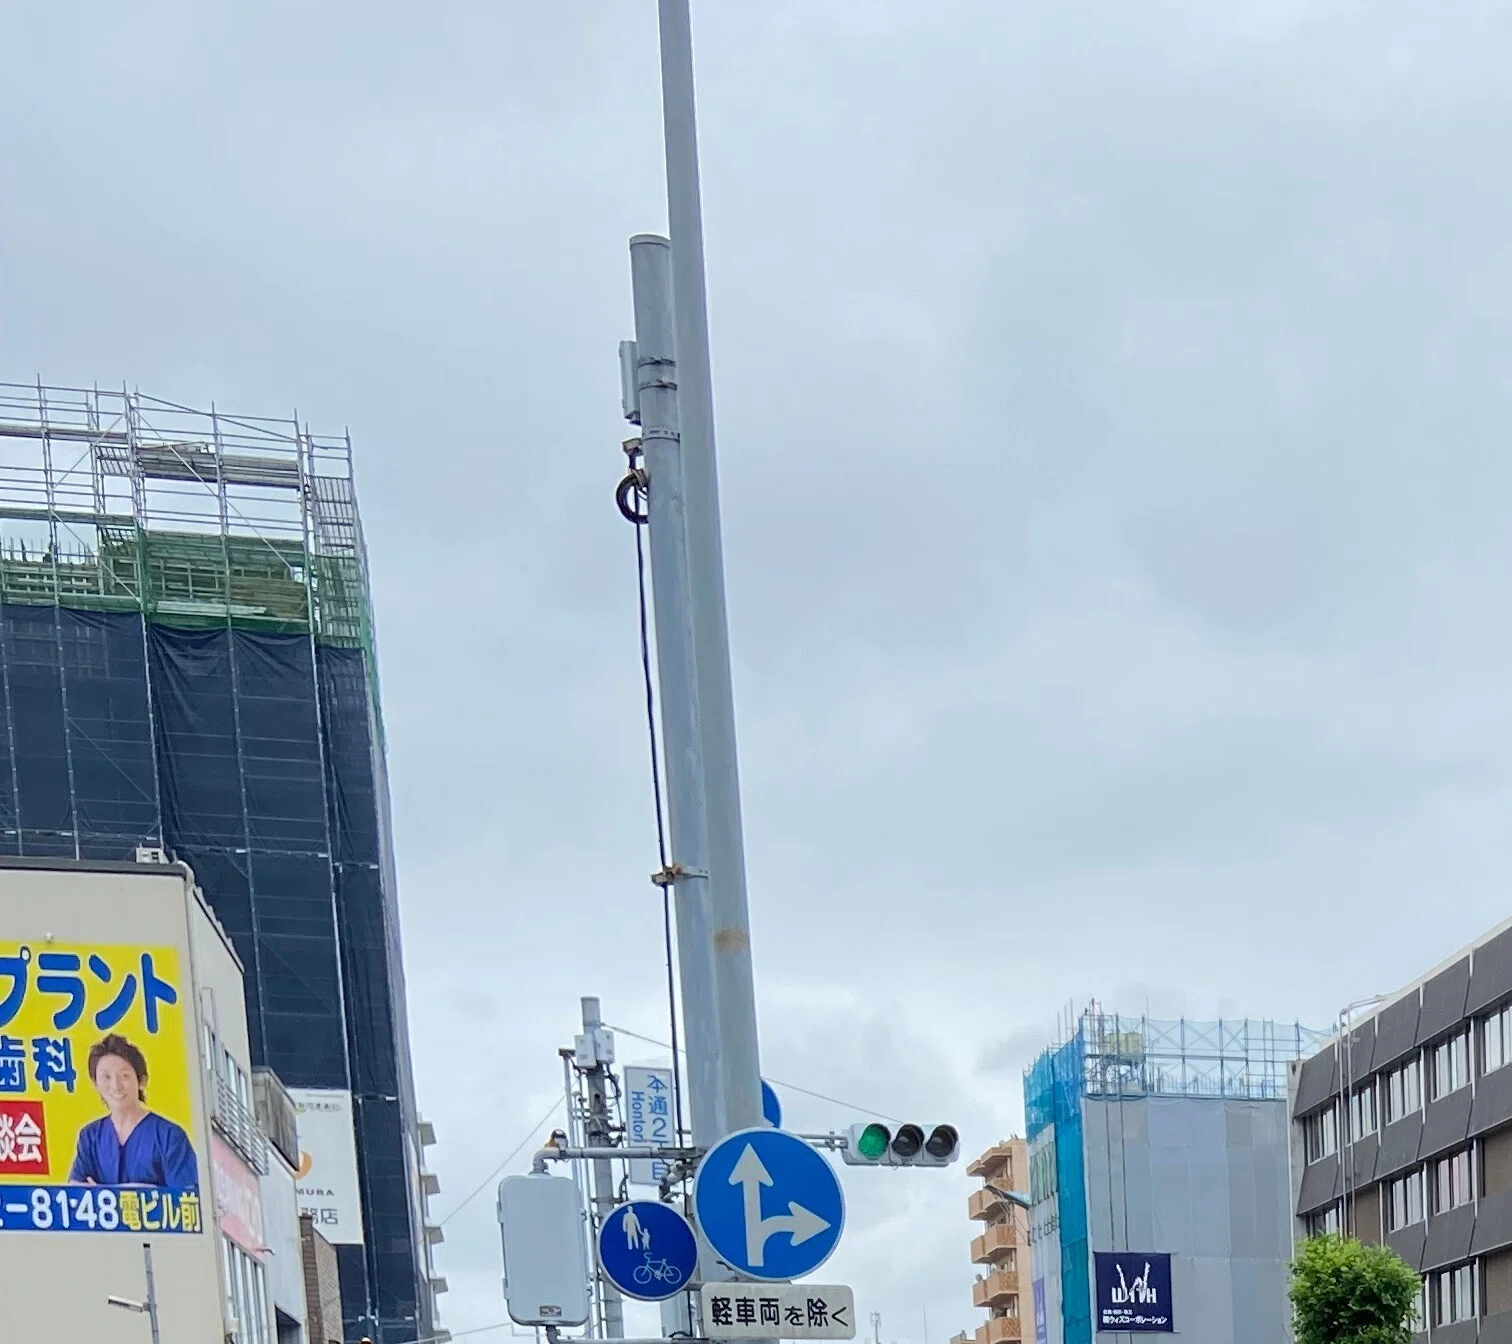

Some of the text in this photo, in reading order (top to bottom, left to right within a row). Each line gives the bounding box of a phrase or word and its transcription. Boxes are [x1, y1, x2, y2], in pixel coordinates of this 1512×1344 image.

[711, 1296, 848, 1327] 軽車両を除く
